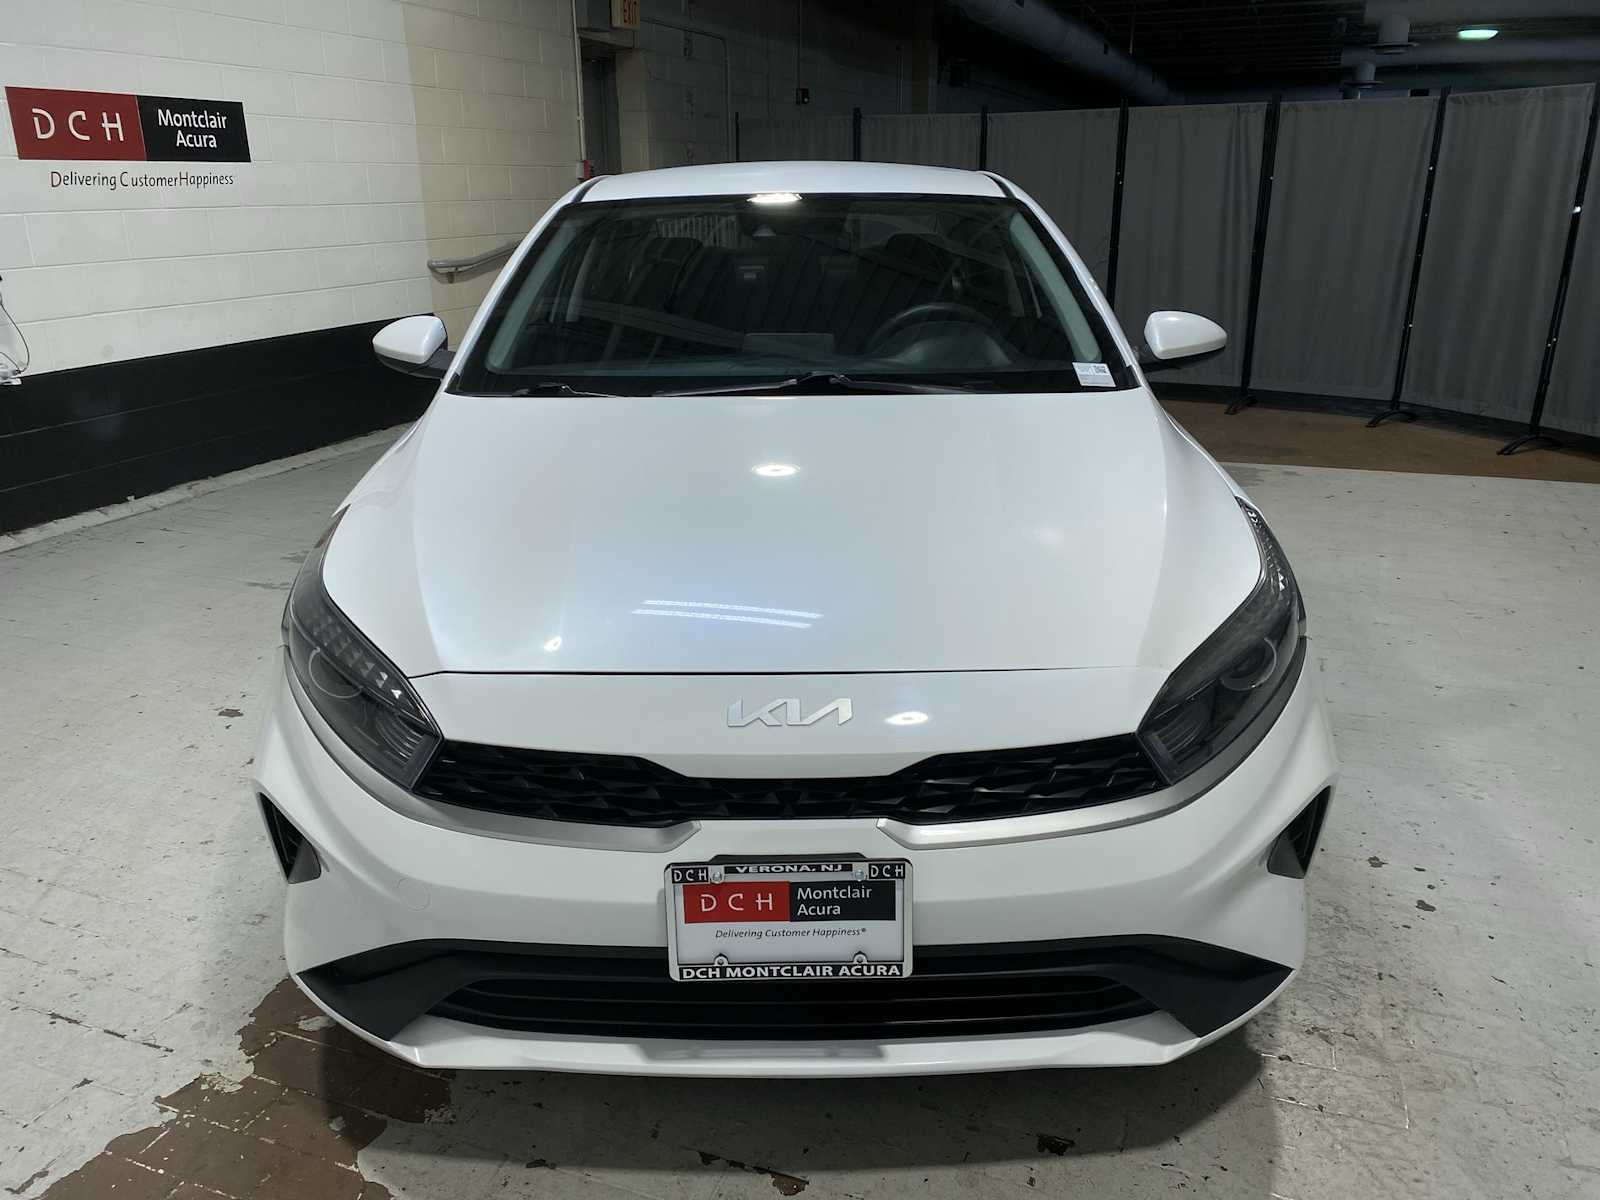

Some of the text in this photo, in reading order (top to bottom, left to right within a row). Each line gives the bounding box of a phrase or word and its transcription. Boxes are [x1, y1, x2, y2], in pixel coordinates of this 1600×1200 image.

[31, 107, 124, 142] DCH
[157, 108, 228, 129] Montclair
[175, 130, 218, 148] Acura
[50, 171, 117, 190] Delivering
[673, 869, 708, 882] DCH
[820, 864, 844, 873] NJ
[870, 865, 905, 877] DCH
[797, 886, 873, 900] Montclair
[700, 893, 774, 912] DCH
[797, 903, 842, 916] Acura
[715, 928, 763, 939] Delivering
[765, 928, 811, 938] Customer
[682, 964, 901, 979] DCH MONTCLAIR ACURA
